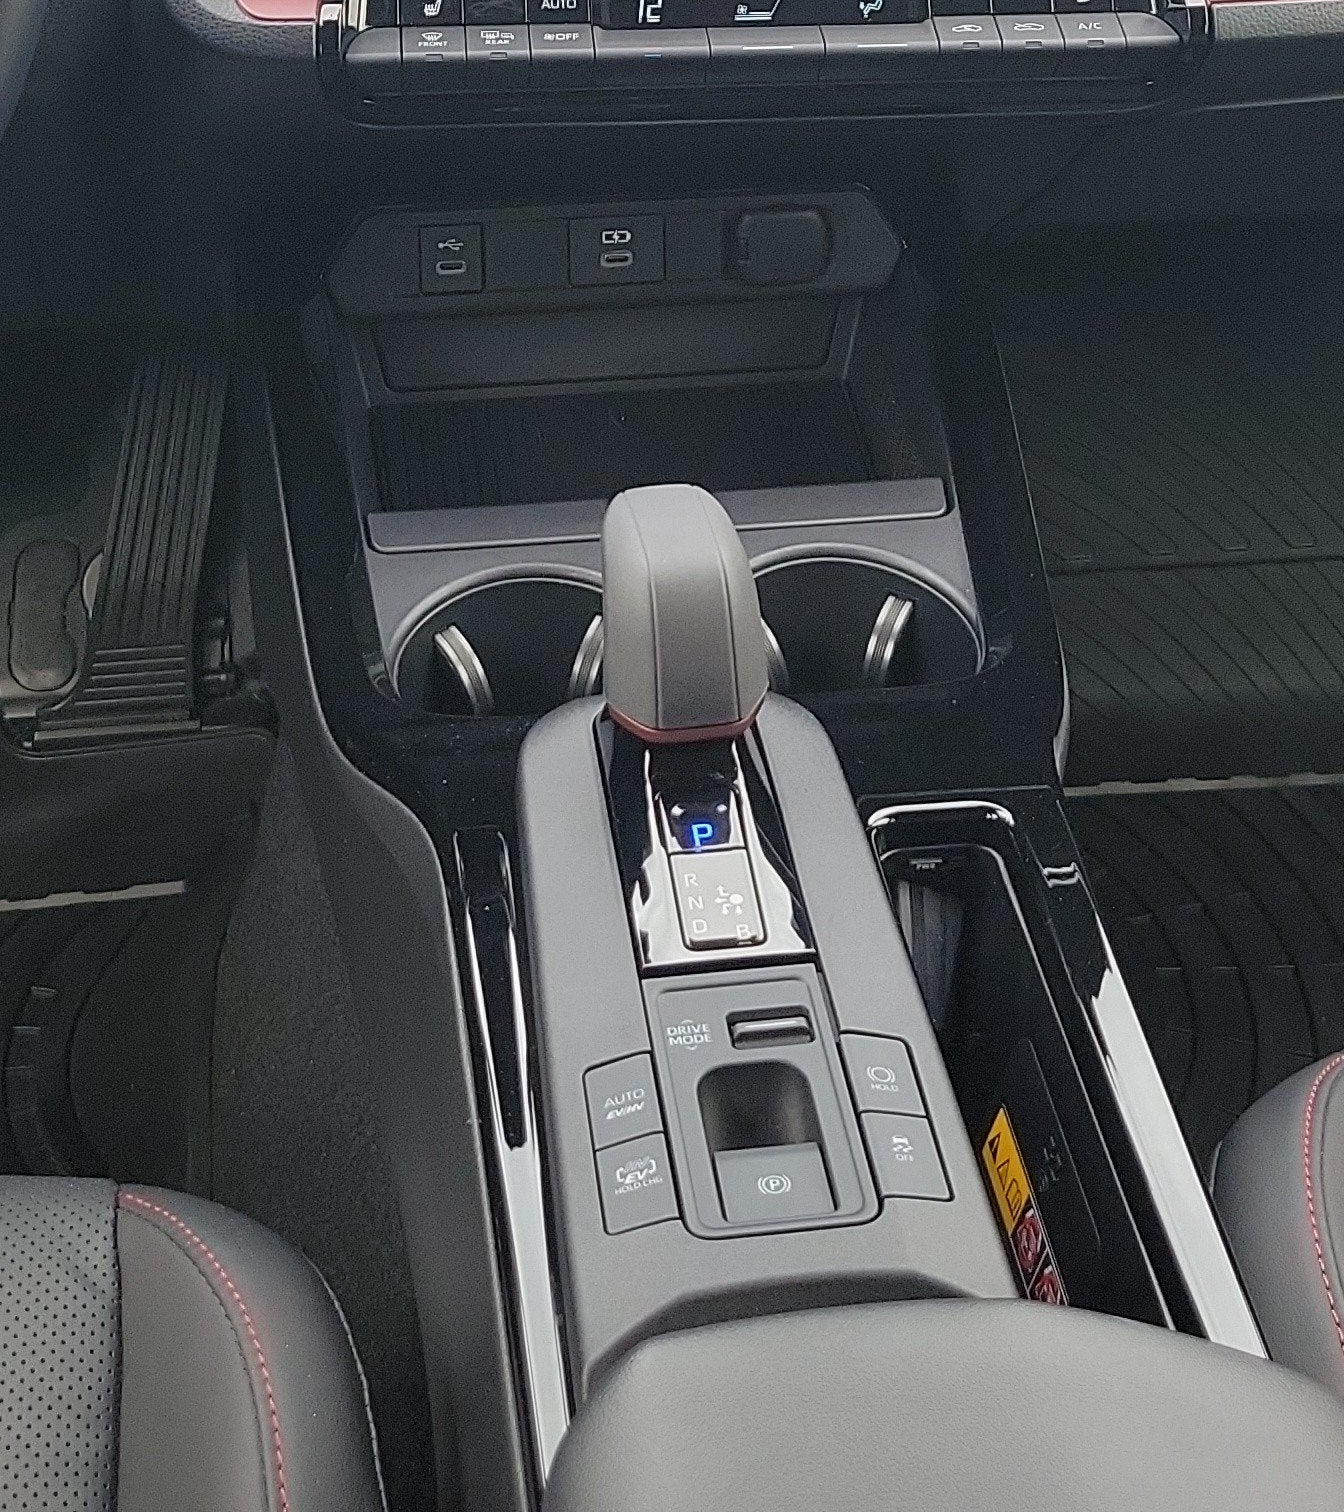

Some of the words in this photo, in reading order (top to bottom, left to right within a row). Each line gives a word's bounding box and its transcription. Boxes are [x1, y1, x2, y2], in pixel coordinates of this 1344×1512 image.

[1078, 21, 1102, 31] A/C
[555, 32, 580, 41] OFF
[691, 824, 713, 847] P
[684, 873, 699, 887] R
[688, 895, 704, 910] N
[692, 919, 708, 933] D
[736, 924, 751, 939] B
[667, 1023, 710, 1037] DRIVE
[669, 1033, 712, 1046] MODE
[871, 1083, 899, 1092] HOLD
[603, 1088, 645, 1109] AUTO
[614, 1181, 641, 1196] HOLD
